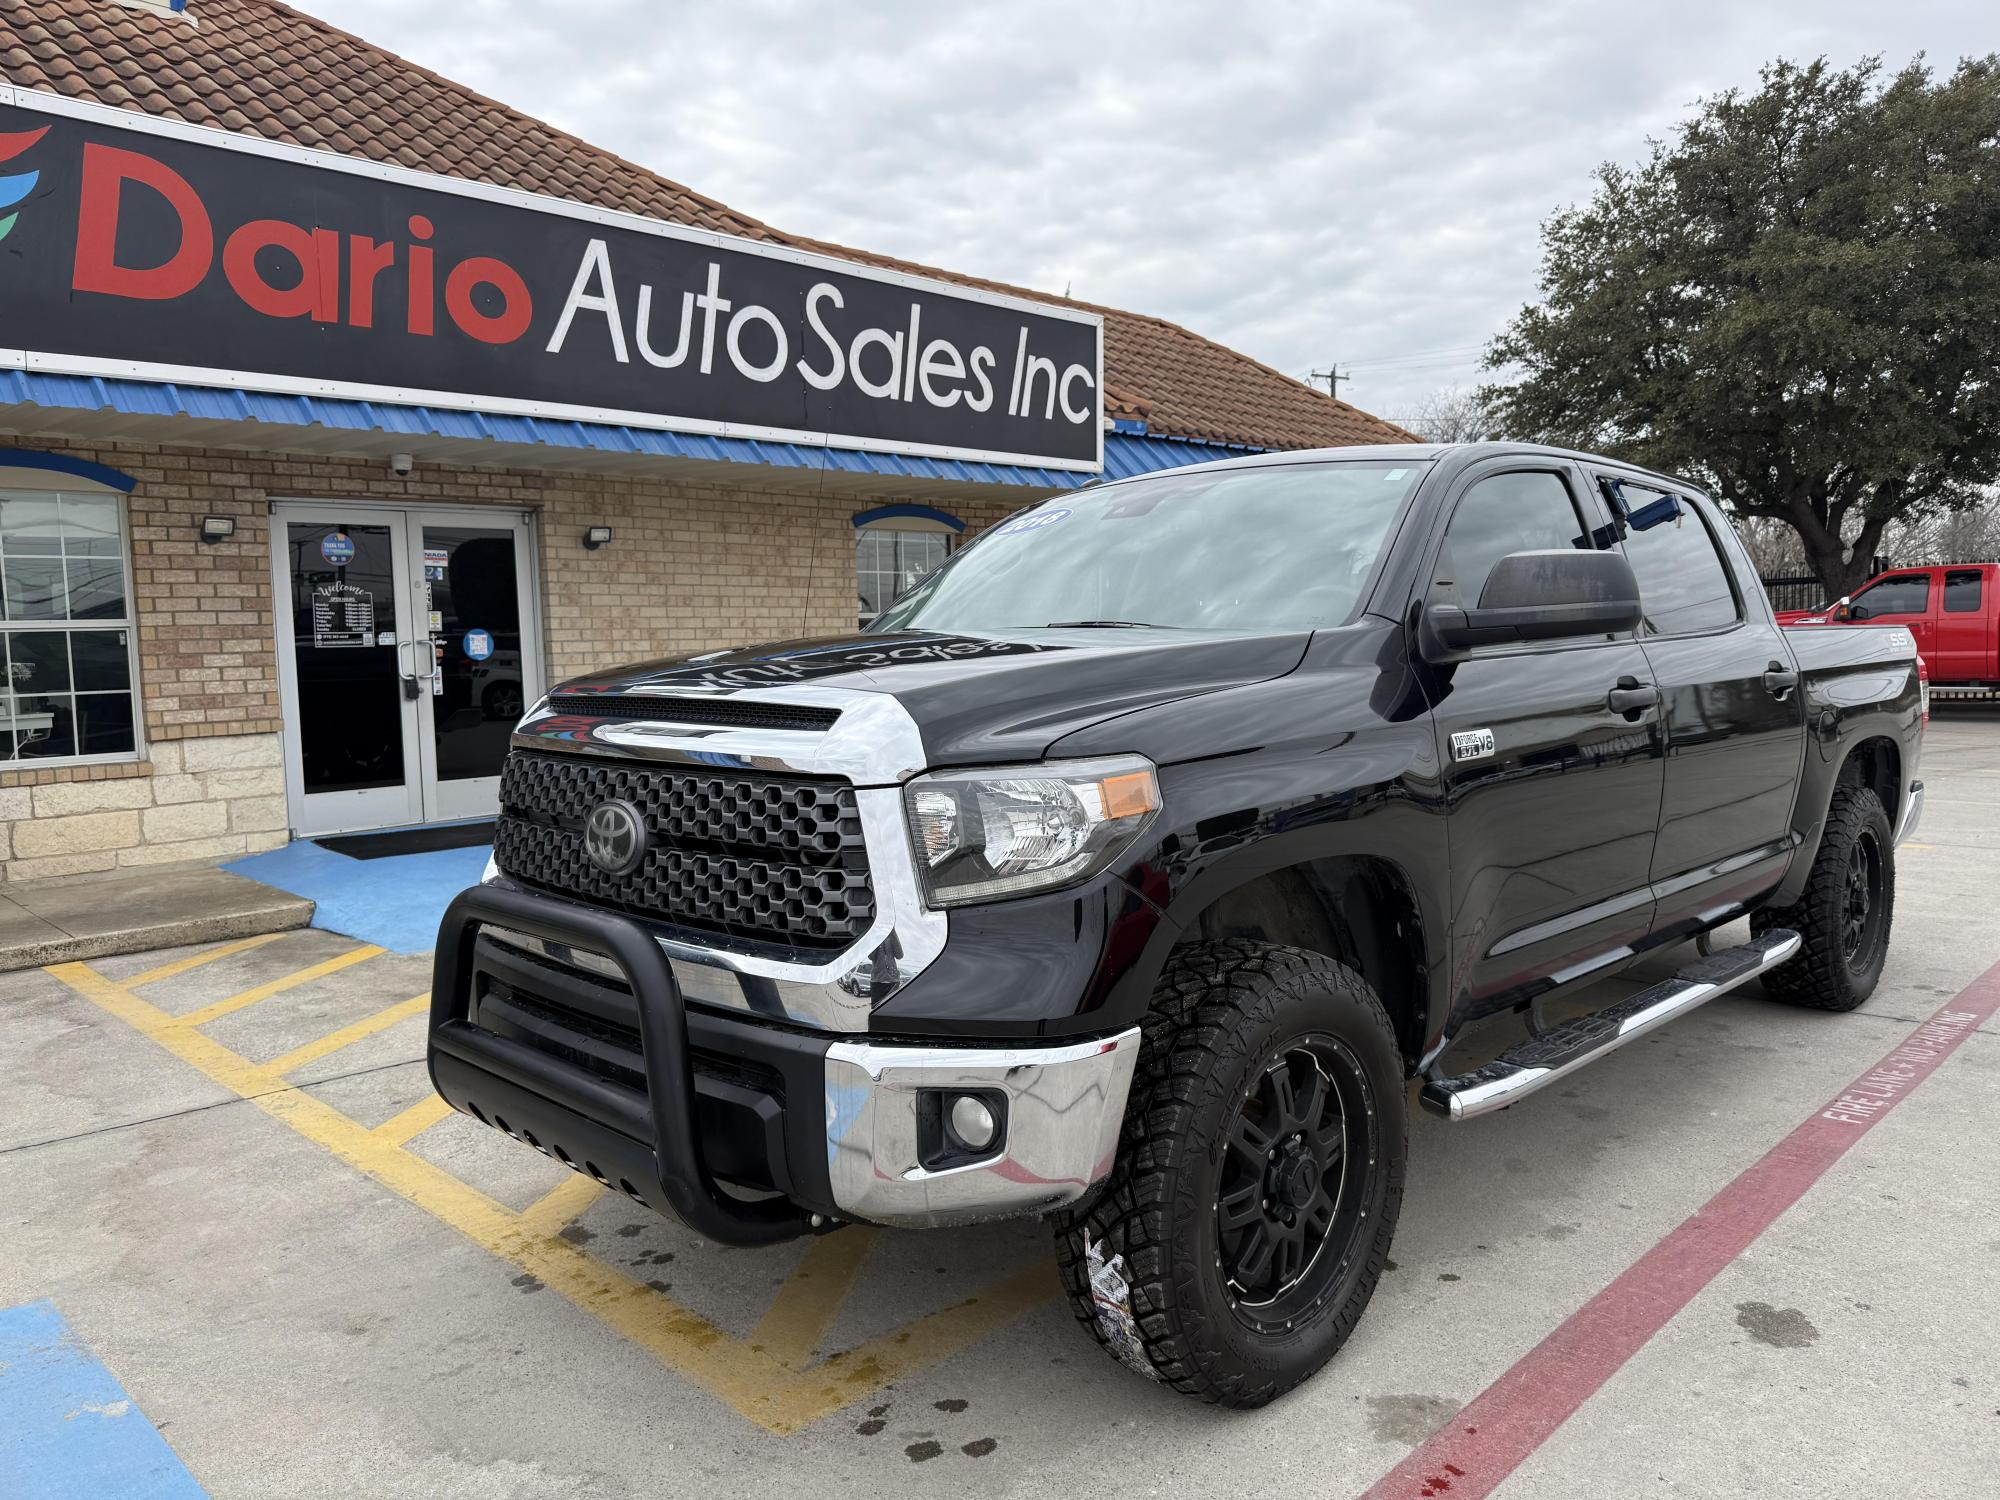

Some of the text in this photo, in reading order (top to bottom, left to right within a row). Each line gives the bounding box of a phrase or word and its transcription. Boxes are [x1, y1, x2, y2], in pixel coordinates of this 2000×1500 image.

[72, 142, 1095, 424] Dario Auto Sales Inc
[318, 581, 365, 597] Welcome
[1478, 734, 1493, 752] V8
[1822, 1010, 1978, 1125] FIRE LANE NO PARKING
